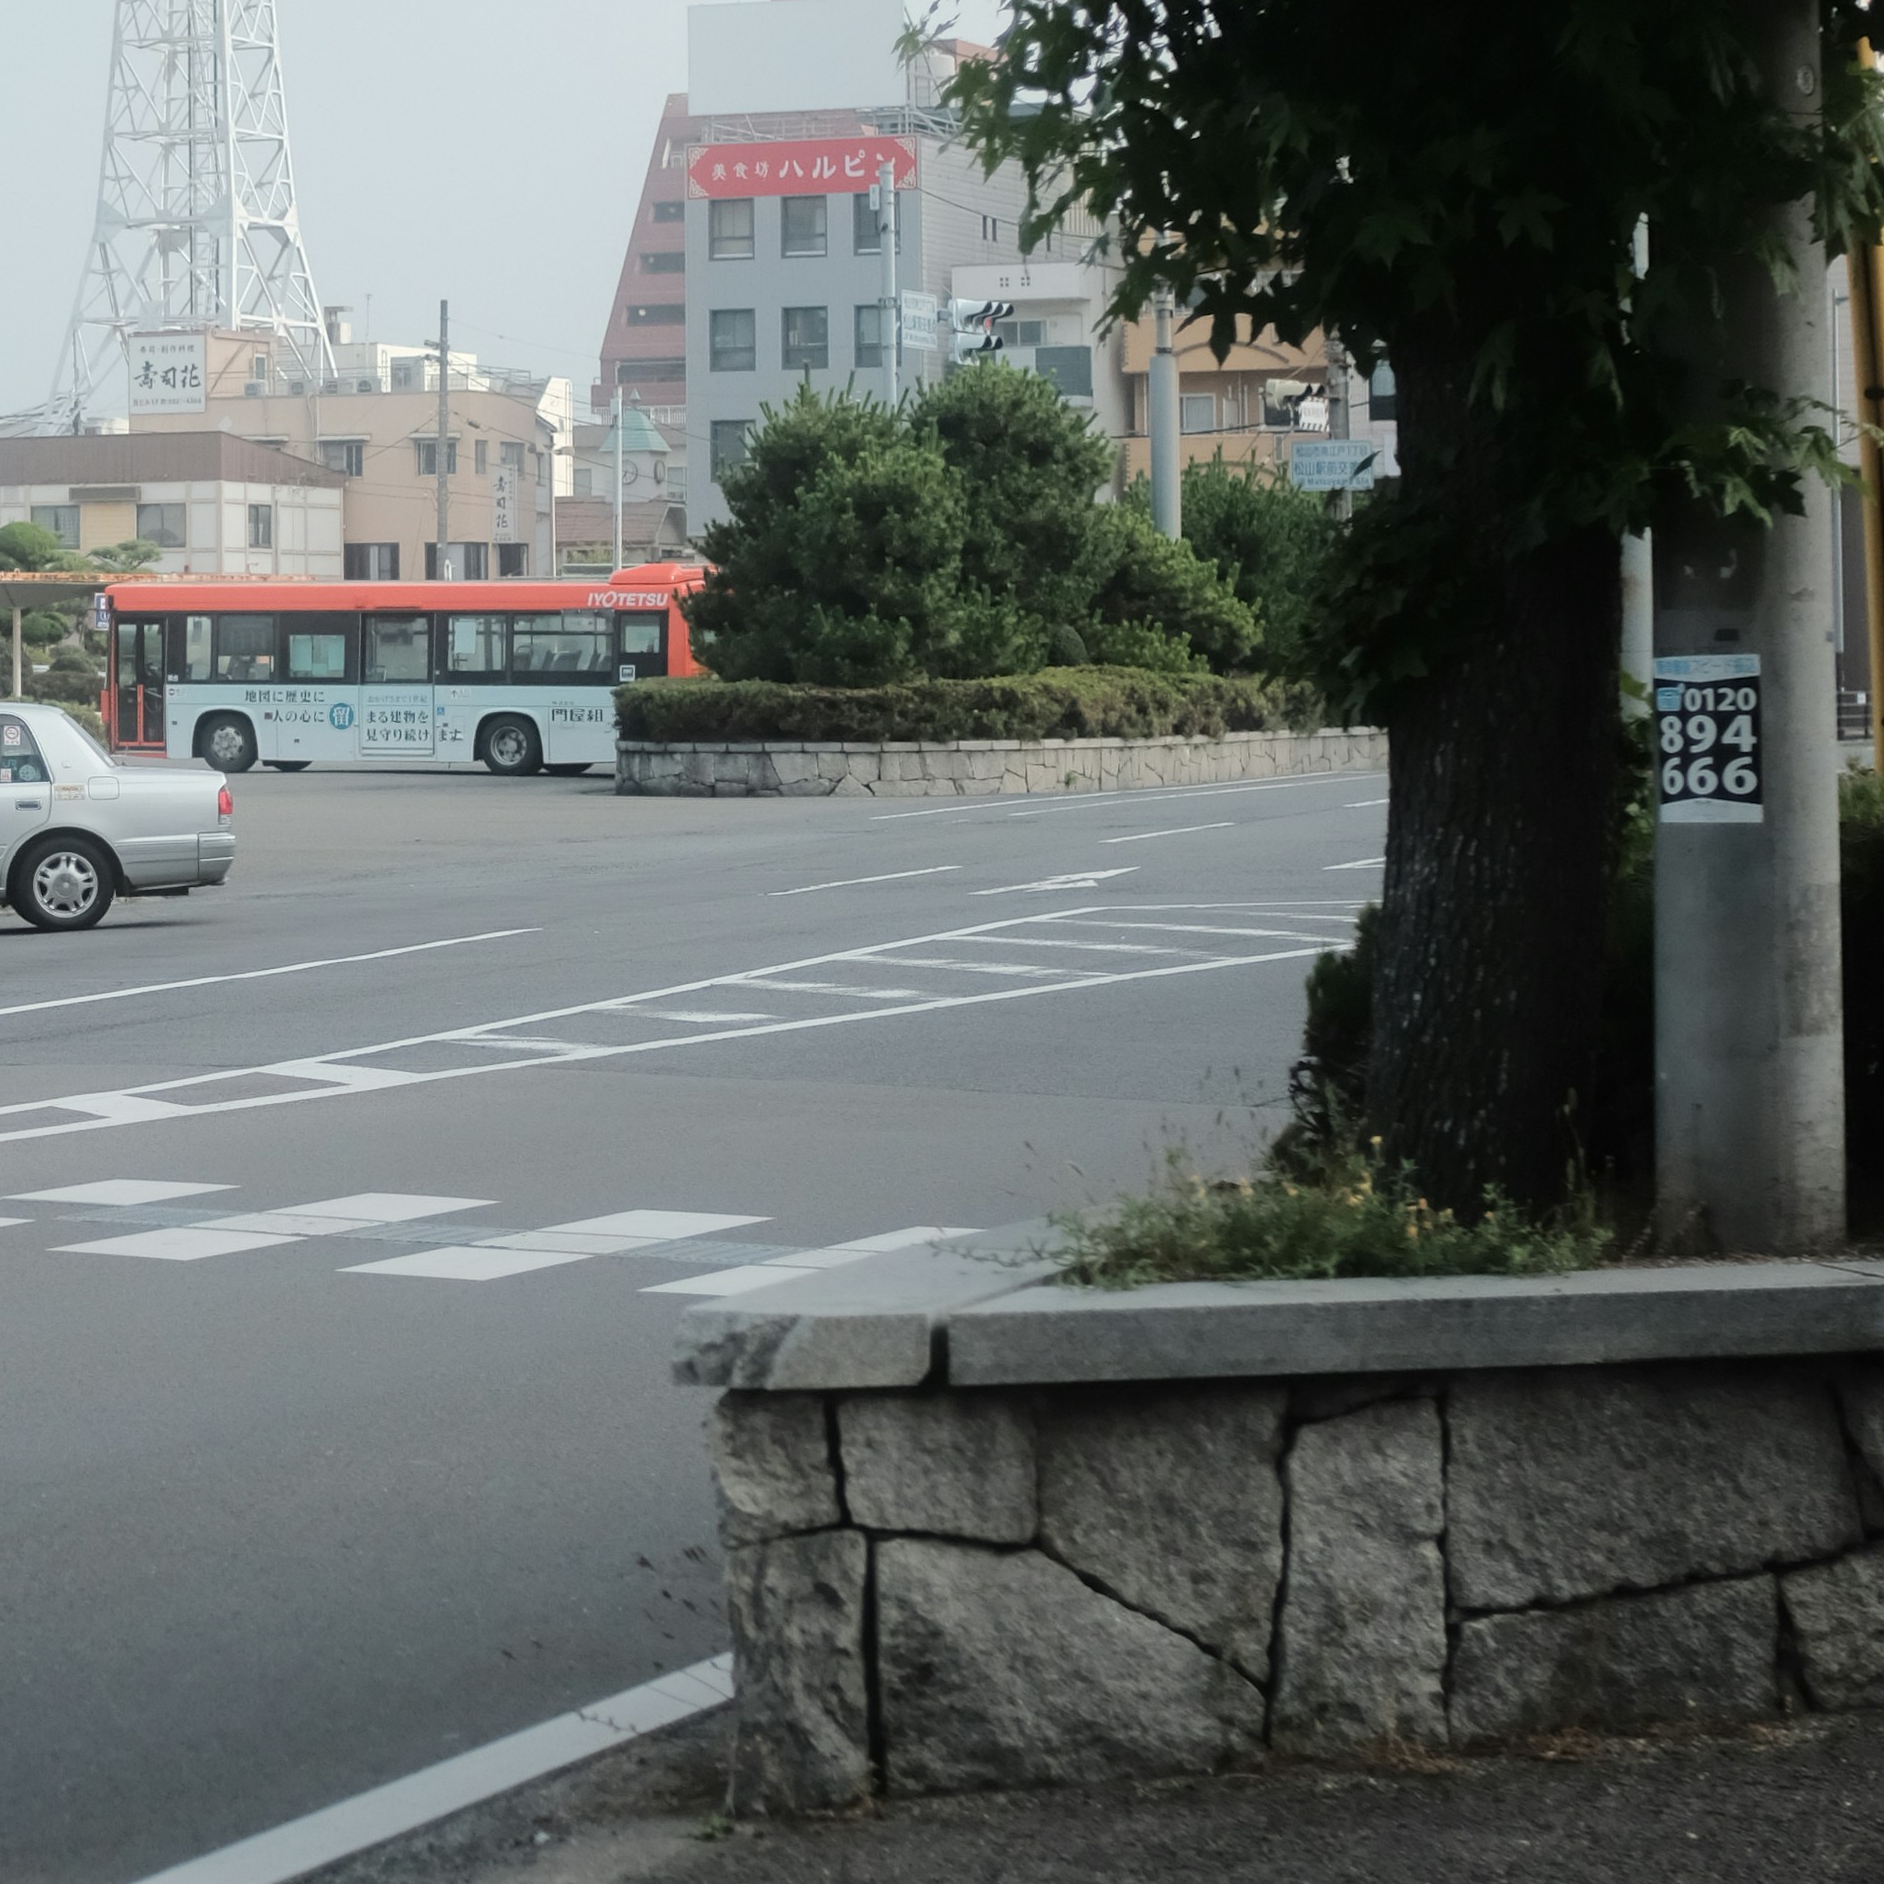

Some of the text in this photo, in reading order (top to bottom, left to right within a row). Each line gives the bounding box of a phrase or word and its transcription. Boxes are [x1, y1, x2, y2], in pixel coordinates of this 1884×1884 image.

[587, 591, 669, 608] IYOTETSU
[244, 690, 325, 703] 地図に歴史に
[1683, 687, 1758, 712] 0120
[272, 709, 325, 724] 人の心に
[367, 710, 429, 724] まる建物を
[1659, 714, 1758, 754] 894
[1662, 756, 1759, 796] 666
